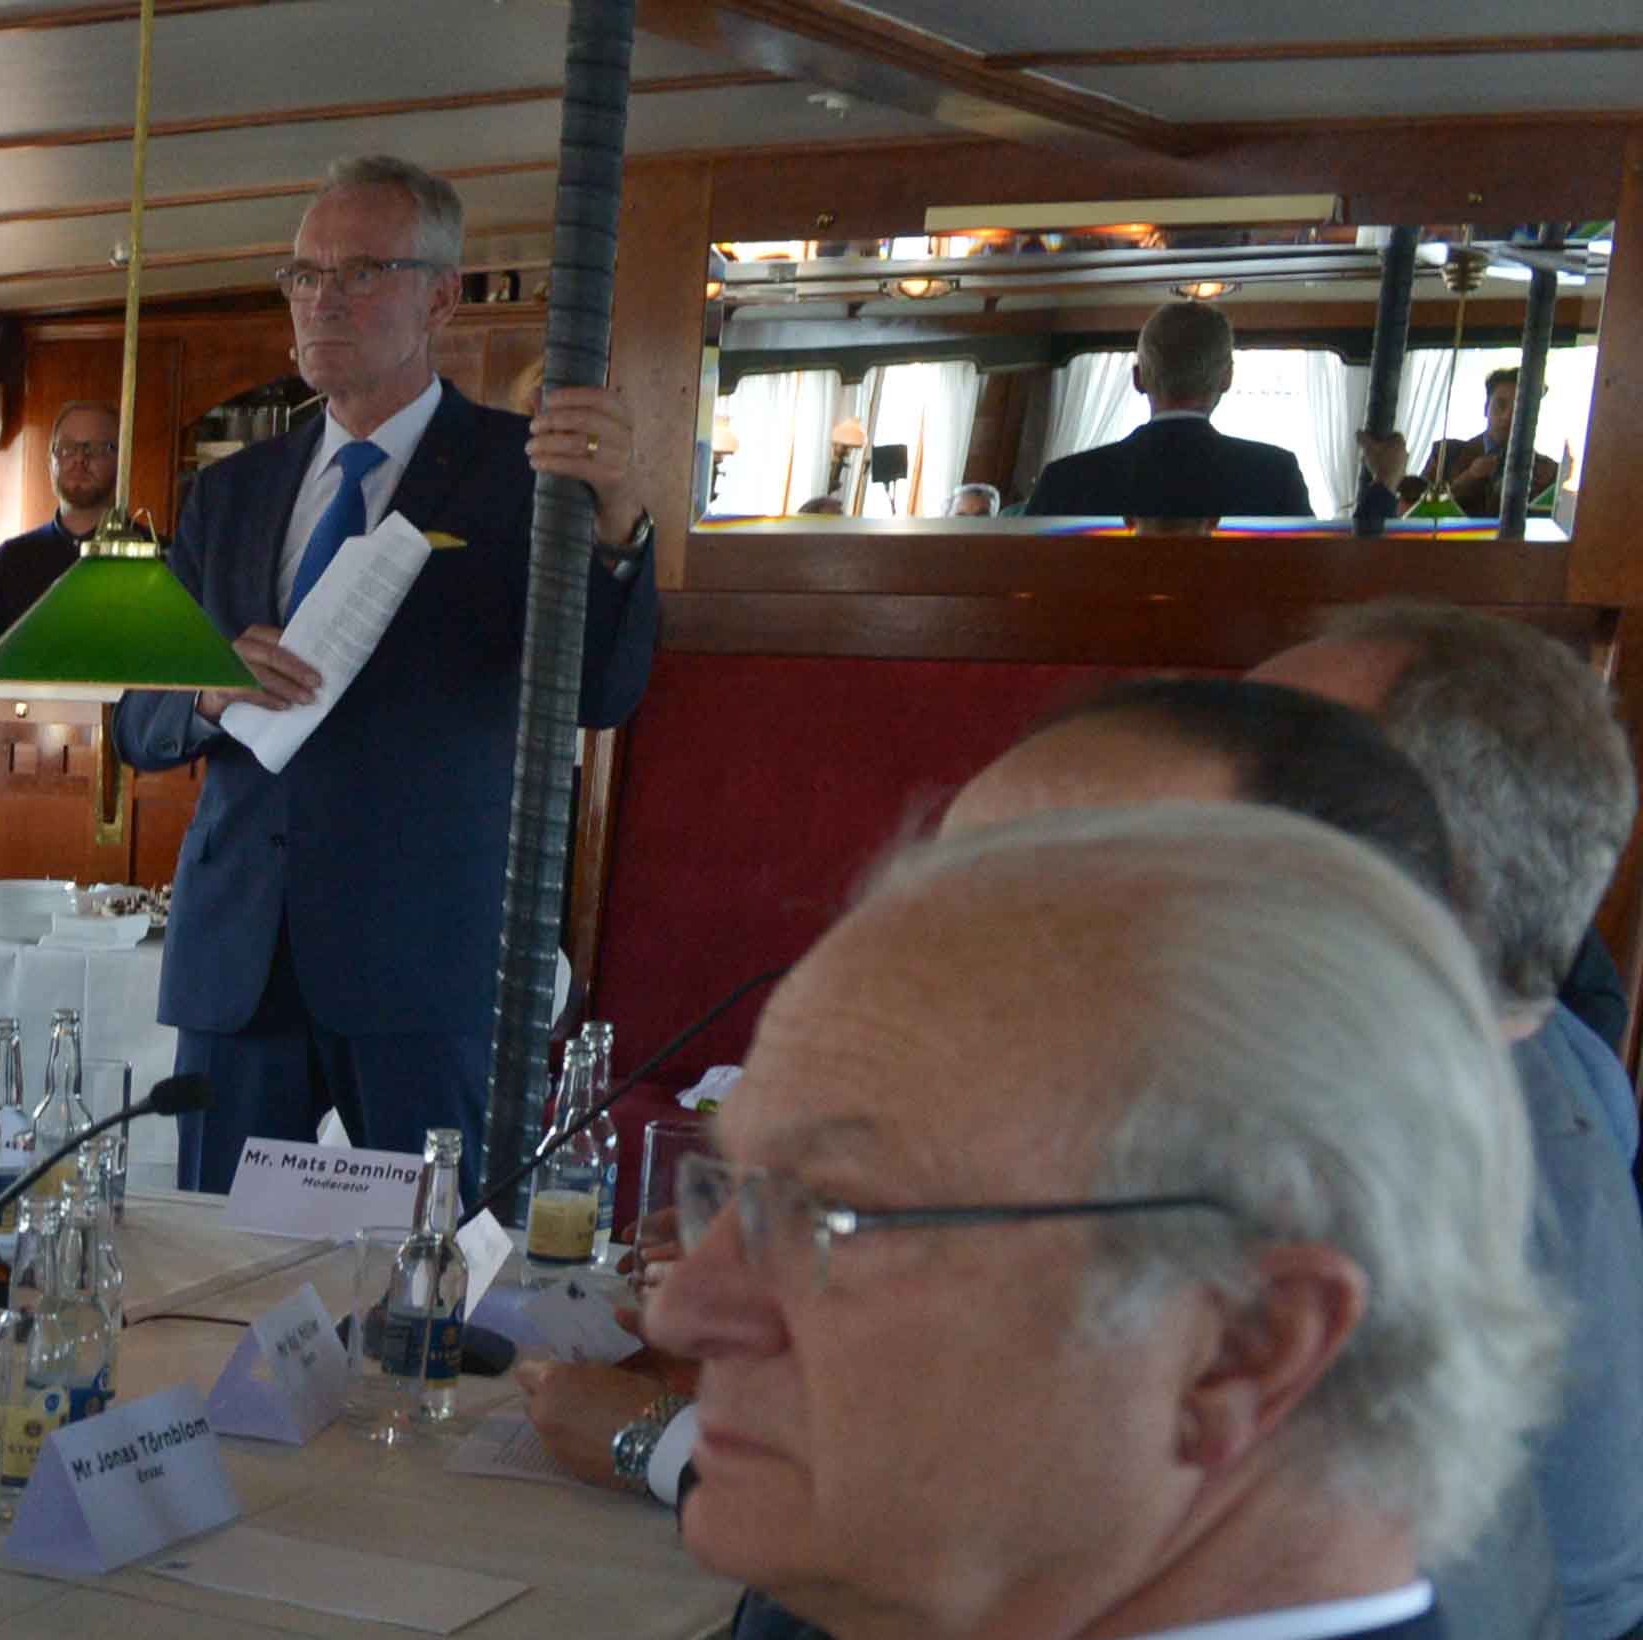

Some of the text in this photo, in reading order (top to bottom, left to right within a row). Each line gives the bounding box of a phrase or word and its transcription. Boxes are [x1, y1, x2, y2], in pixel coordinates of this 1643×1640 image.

[244, 1150, 421, 1184] Mr. Mats Denning
[302, 1176, 370, 1193] Moderator
[72, 1417, 210, 1481] Mr Jonas Törnblom
